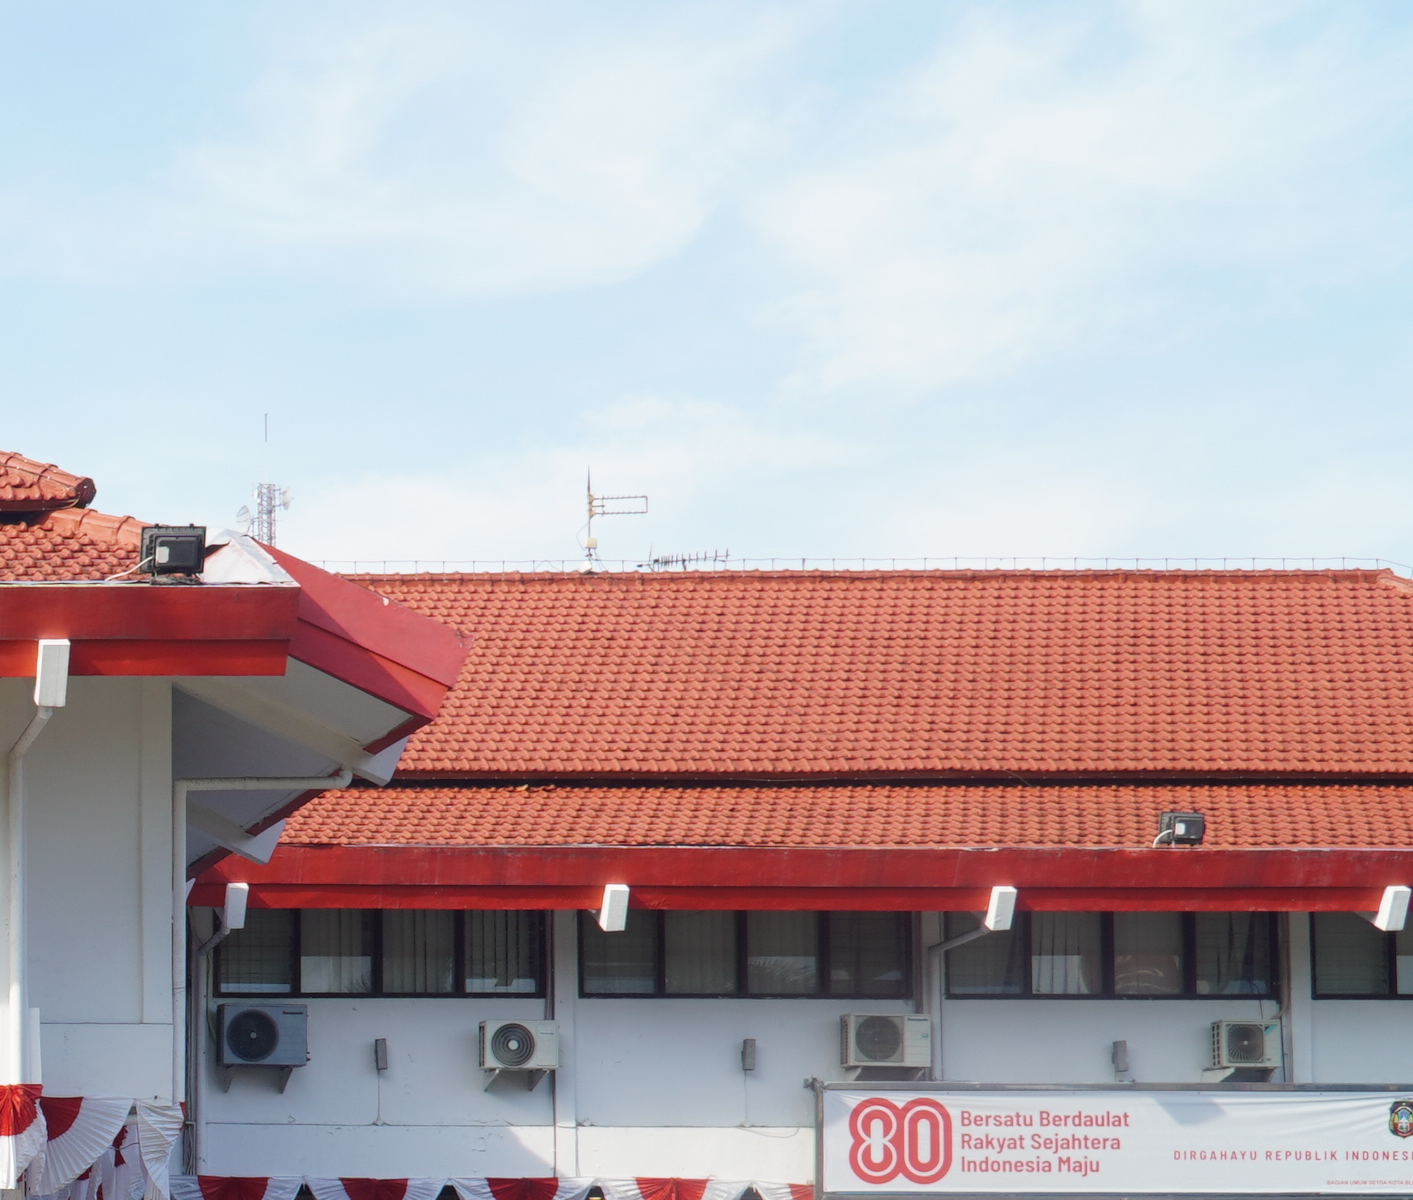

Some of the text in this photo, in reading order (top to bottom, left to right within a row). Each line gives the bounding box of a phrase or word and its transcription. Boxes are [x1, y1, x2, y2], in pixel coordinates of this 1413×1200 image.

[960, 1110, 1130, 1127] Bersatu Berdaulat
[849, 1097, 952, 1184] 80
[960, 1133, 1121, 1153] Rakyat Sejahtera
[1173, 1150, 1257, 1161] DIRGAHAYU
[1265, 1150, 1338, 1161] REPUBLIK
[960, 1156, 1100, 1176] Indonesia Maju
